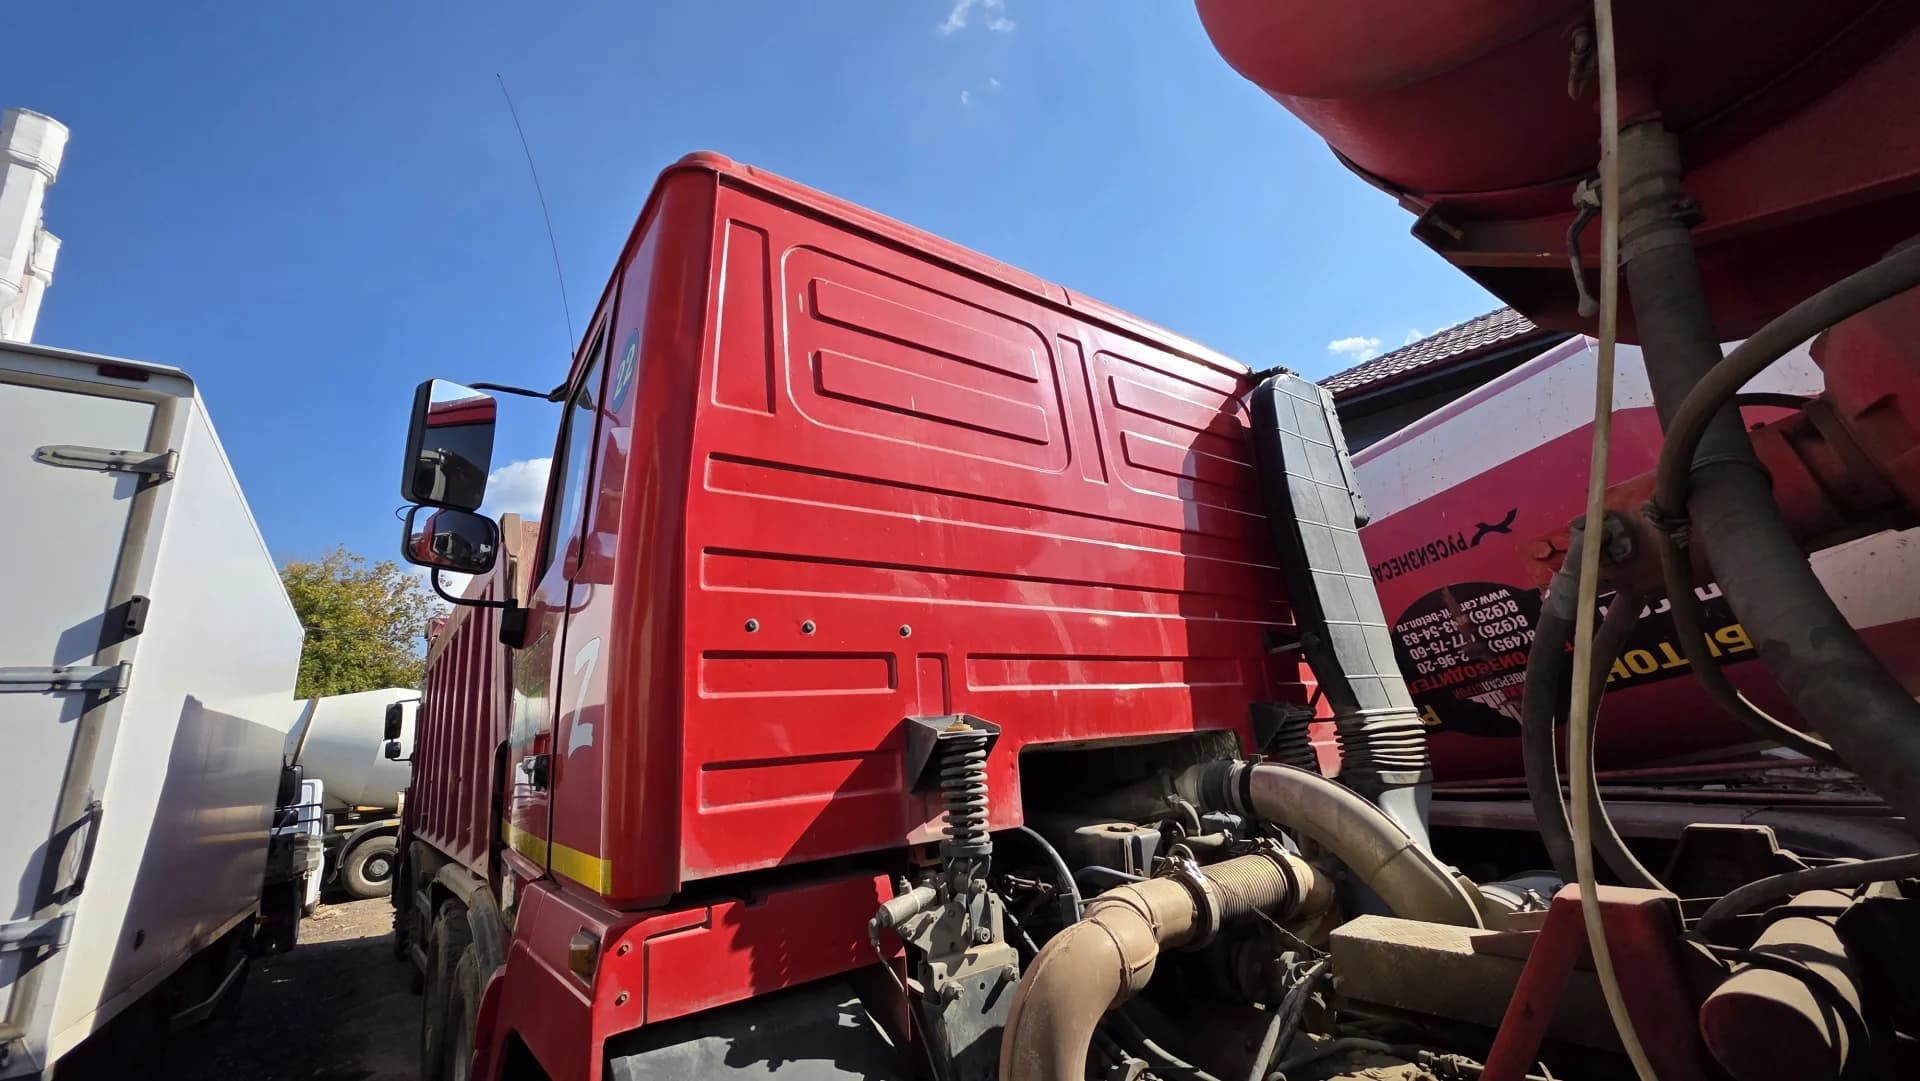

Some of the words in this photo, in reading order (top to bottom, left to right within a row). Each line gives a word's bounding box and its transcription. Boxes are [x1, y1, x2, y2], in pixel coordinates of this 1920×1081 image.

[612, 343, 636, 401] 22
[1370, 531, 1468, 587] РУСБИЗНЕСА
[1469, 600, 1519, 624] 8(926)
[1402, 619, 1459, 647] 43-54-83
[1478, 614, 1529, 639] 8(926)
[1409, 633, 1476, 660] 77-75-60
